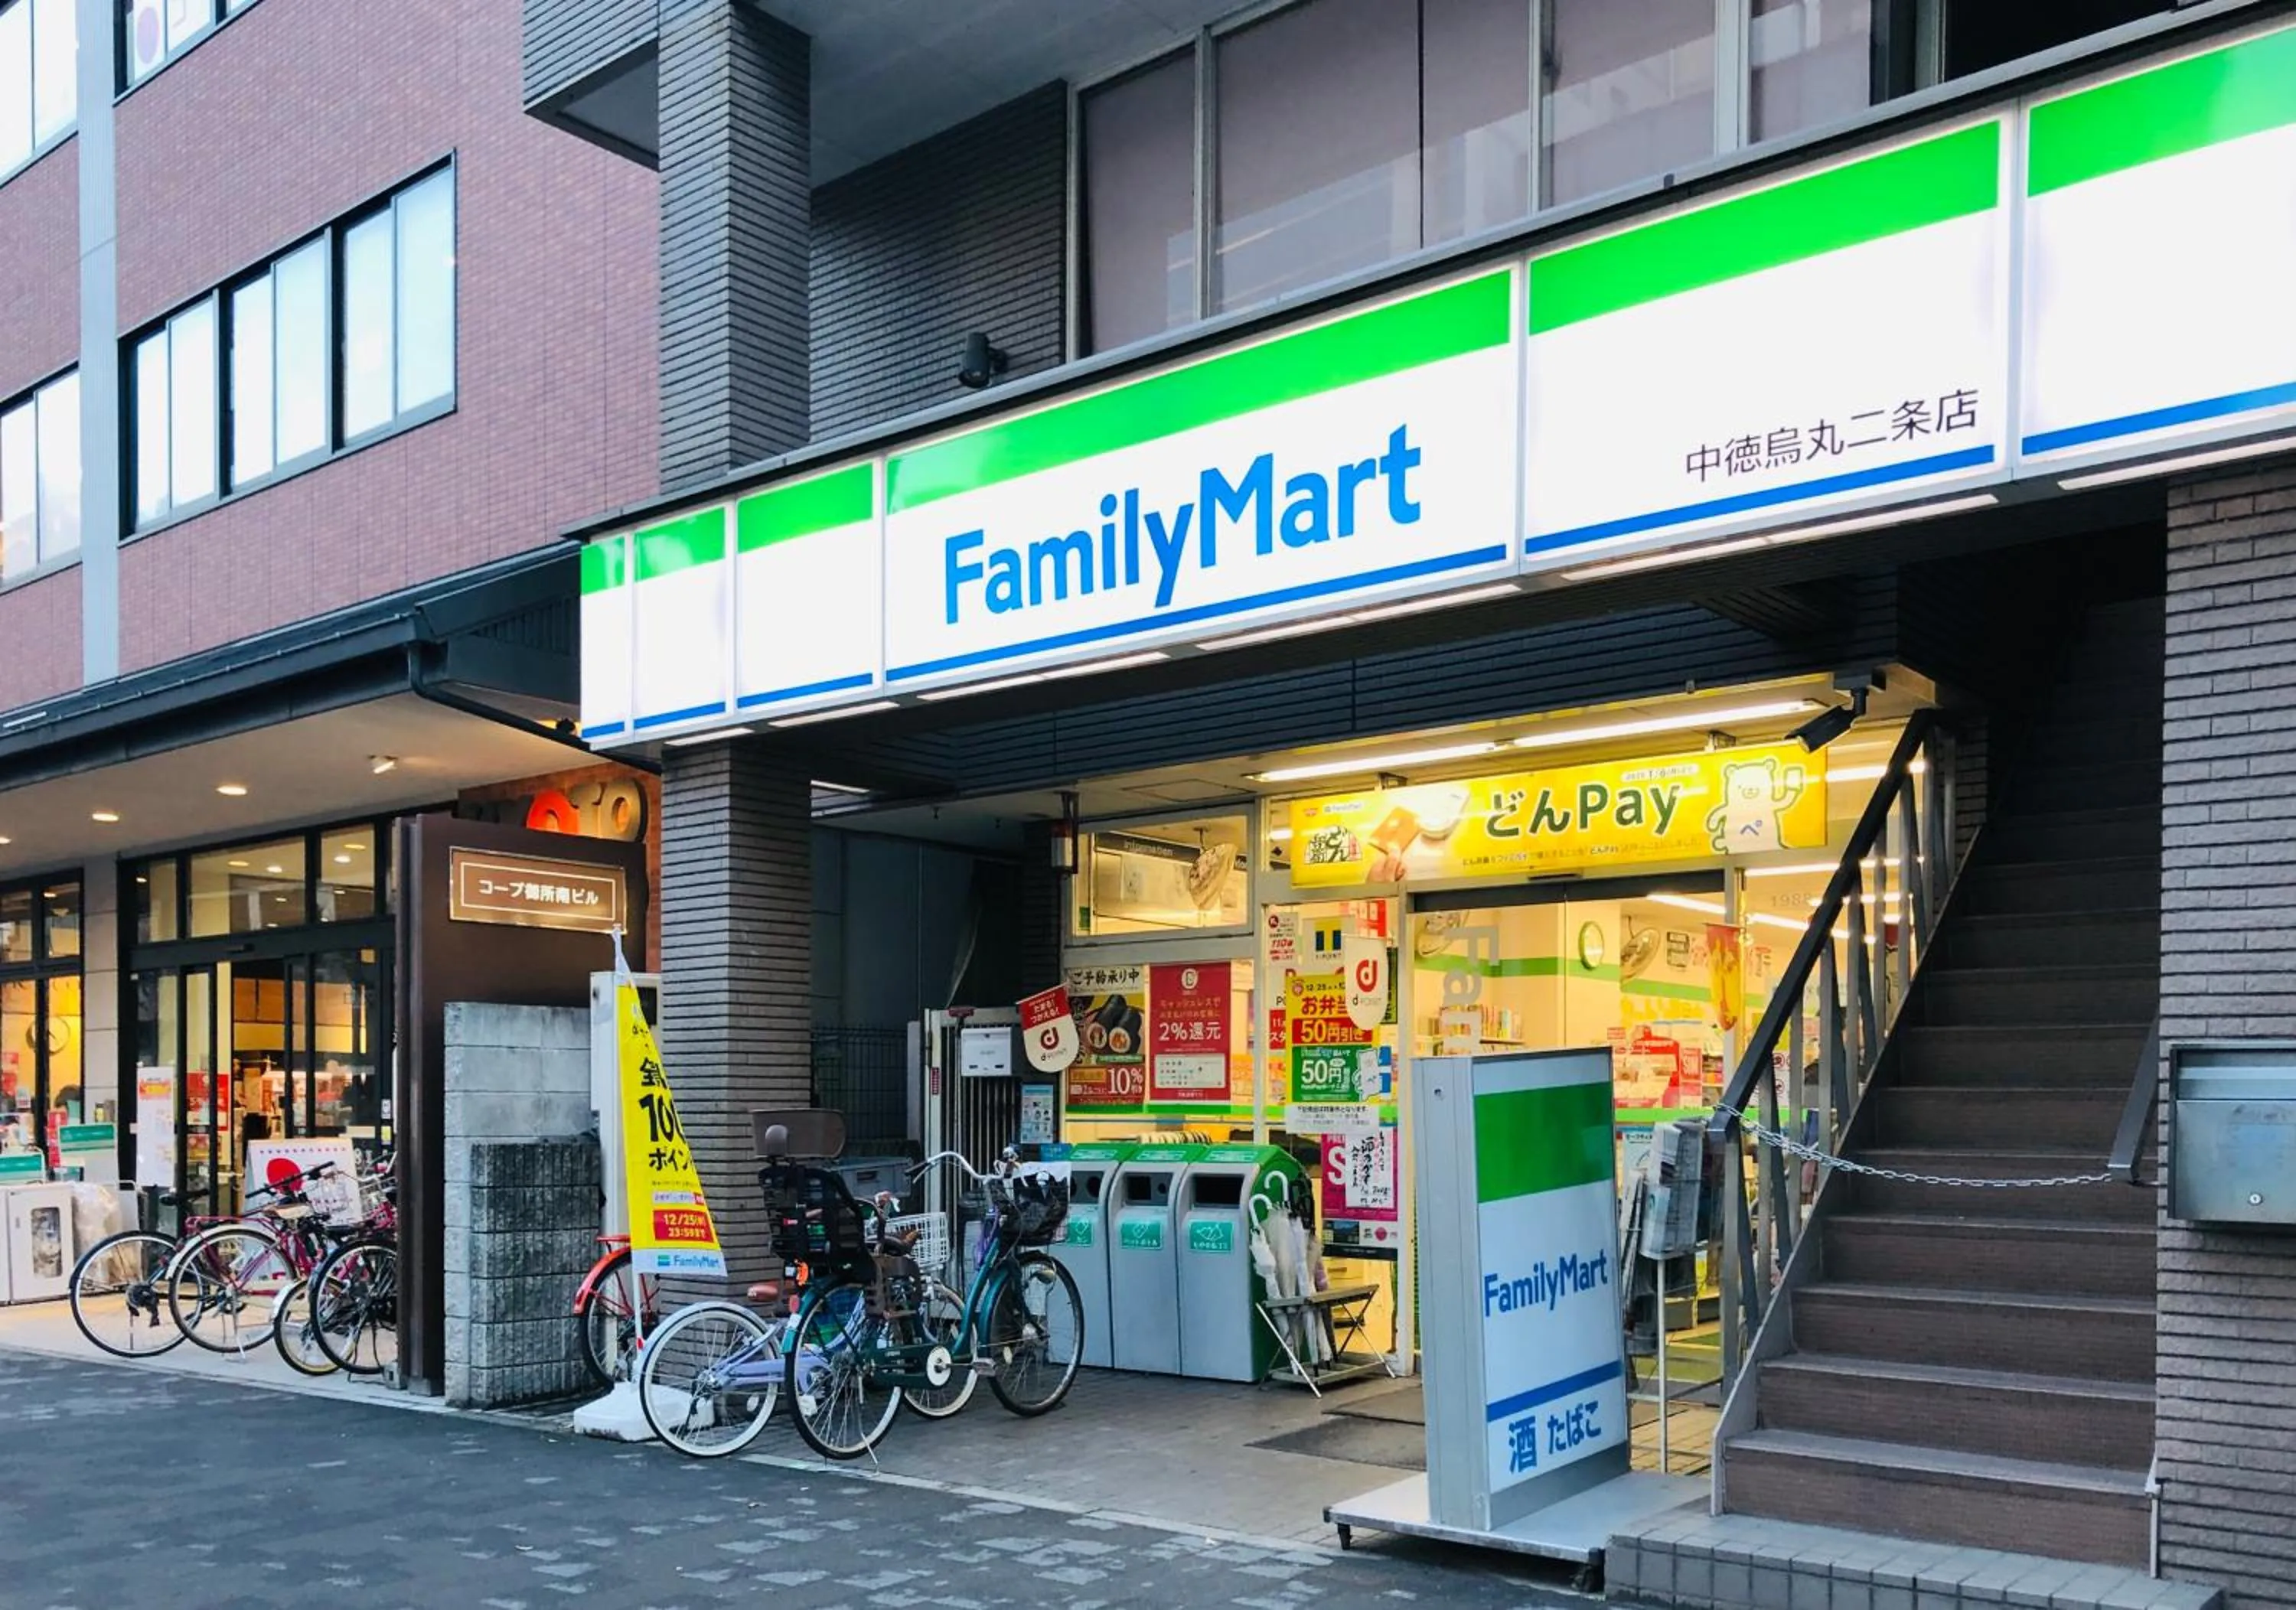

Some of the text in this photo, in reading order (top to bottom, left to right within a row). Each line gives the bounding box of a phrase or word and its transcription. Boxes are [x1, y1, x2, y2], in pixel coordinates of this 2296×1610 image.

[1686, 389, 1979, 483] 中徳烏丸二条店
[946, 423, 1421, 624] FamilyMart
[1486, 784, 1681, 837] どんPay
[478, 879, 598, 905] コープ御所南ビル
[1158, 1022, 1221, 1041] 2%還元
[1483, 1249, 1608, 1317] FamilyMart
[1508, 1400, 1602, 1475] 酒 たばこ
